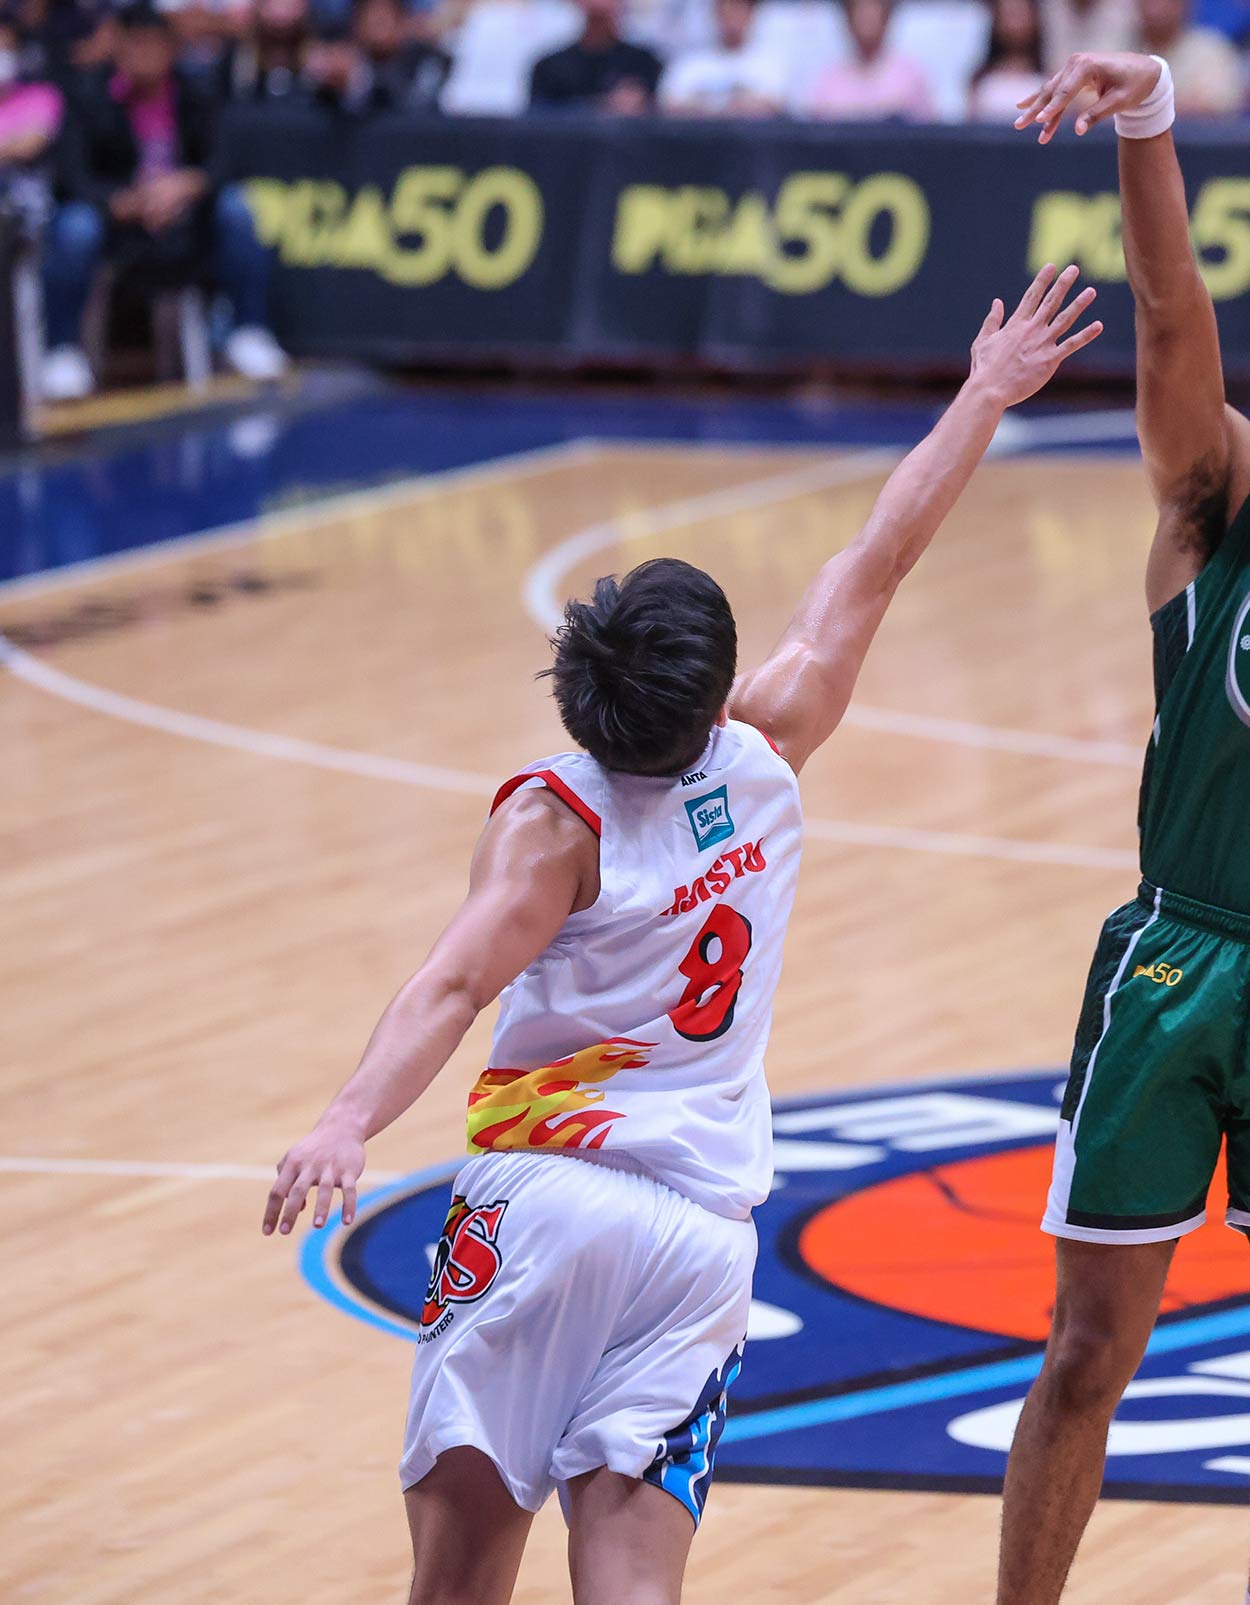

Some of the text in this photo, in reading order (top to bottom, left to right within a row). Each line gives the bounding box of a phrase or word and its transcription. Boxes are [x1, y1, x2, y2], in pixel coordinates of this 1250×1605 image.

[680, 771, 708, 787] ANTA
[696, 803, 723, 828] Sista
[666, 902, 753, 1043] 8
